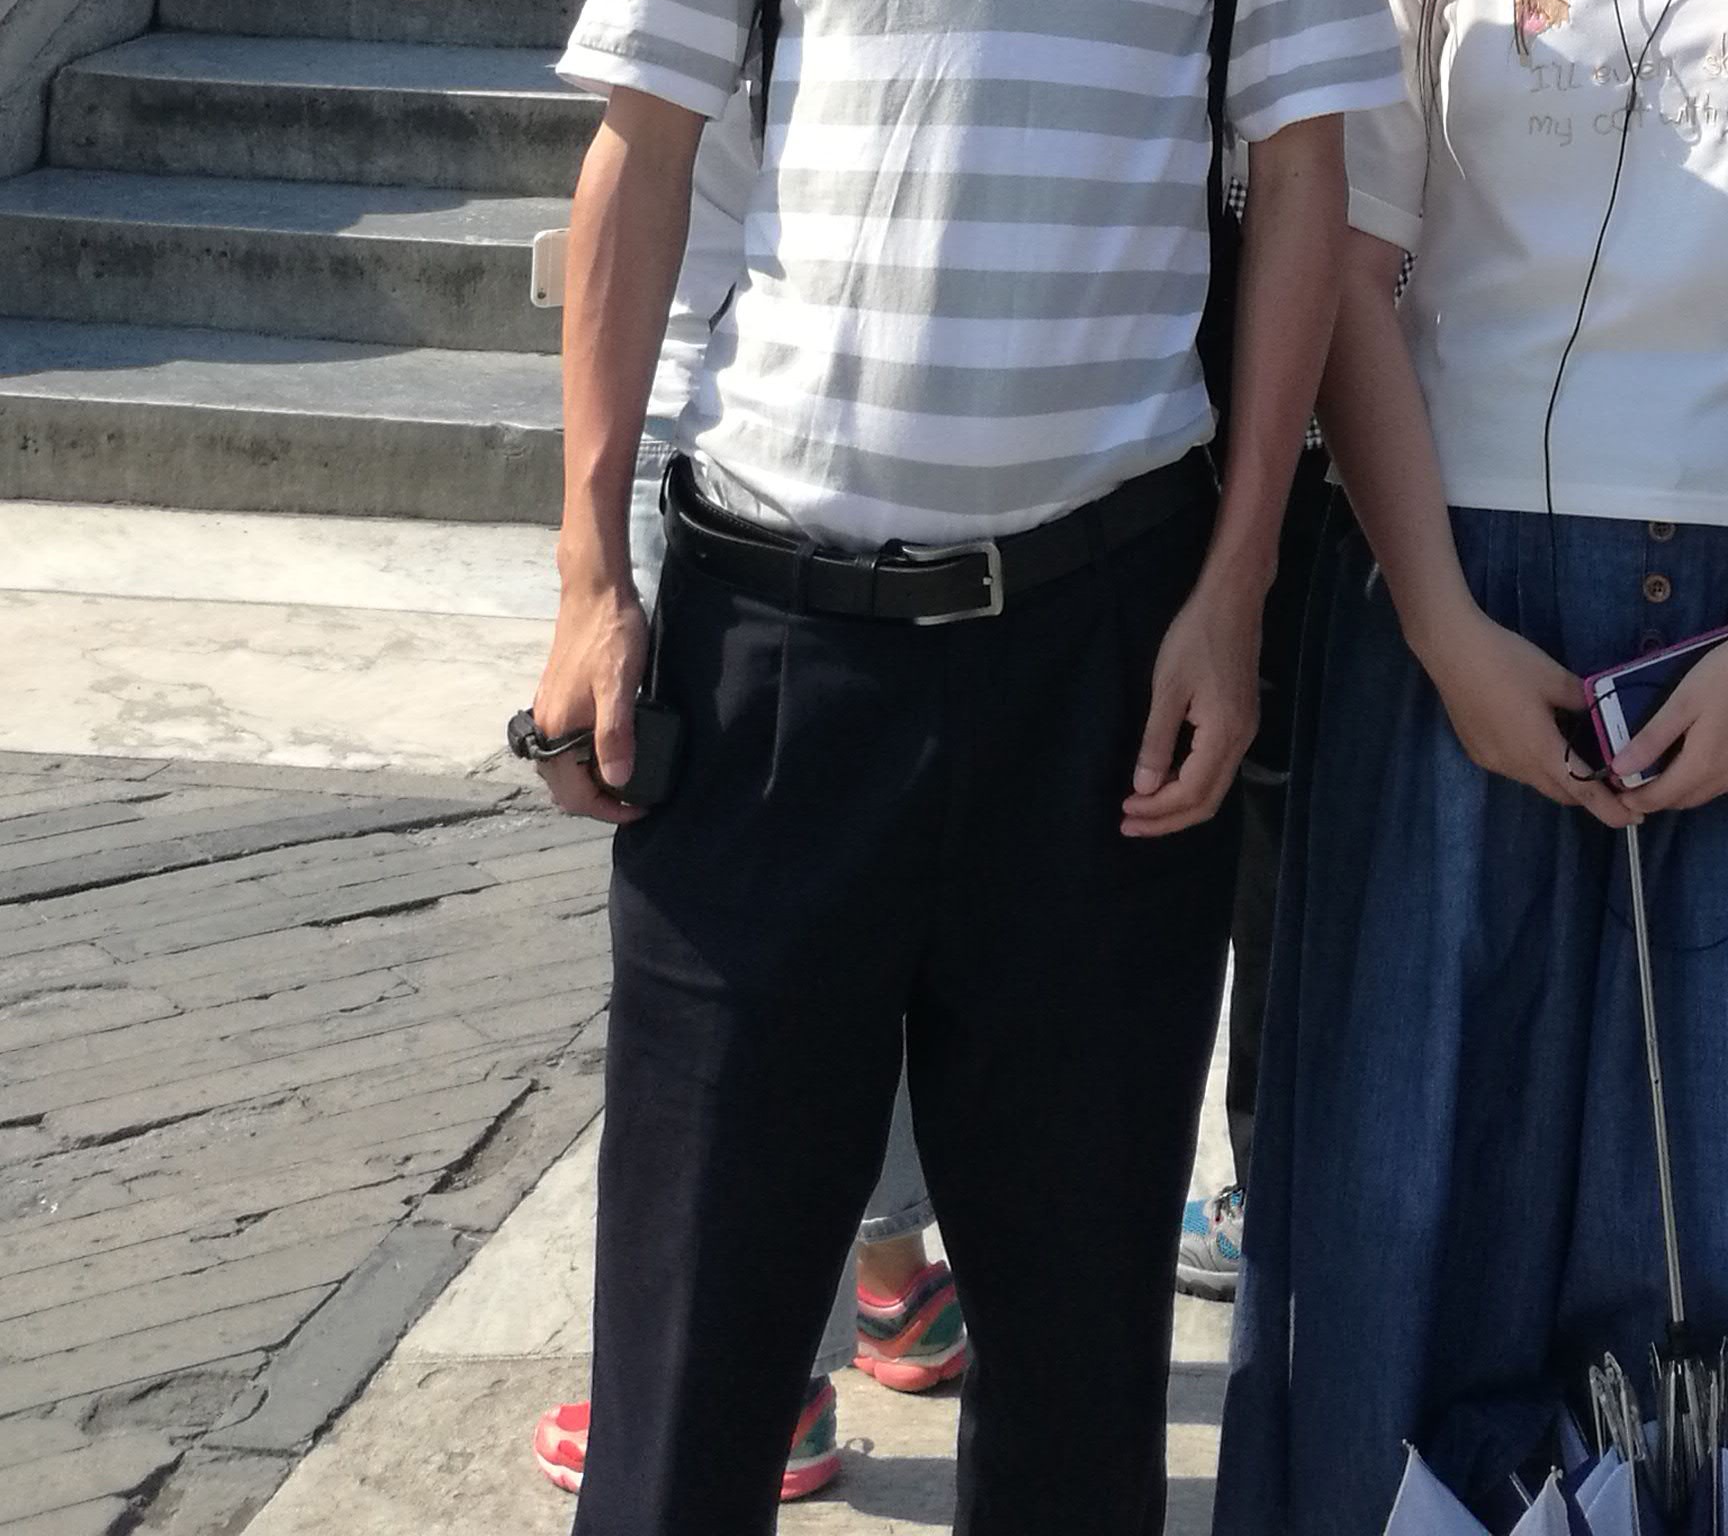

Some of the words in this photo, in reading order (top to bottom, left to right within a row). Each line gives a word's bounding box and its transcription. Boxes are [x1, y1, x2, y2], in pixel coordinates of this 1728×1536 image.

[1592, 57, 1674, 85] even
[1528, 114, 1573, 147] my
[1659, 91, 1718, 126] with
